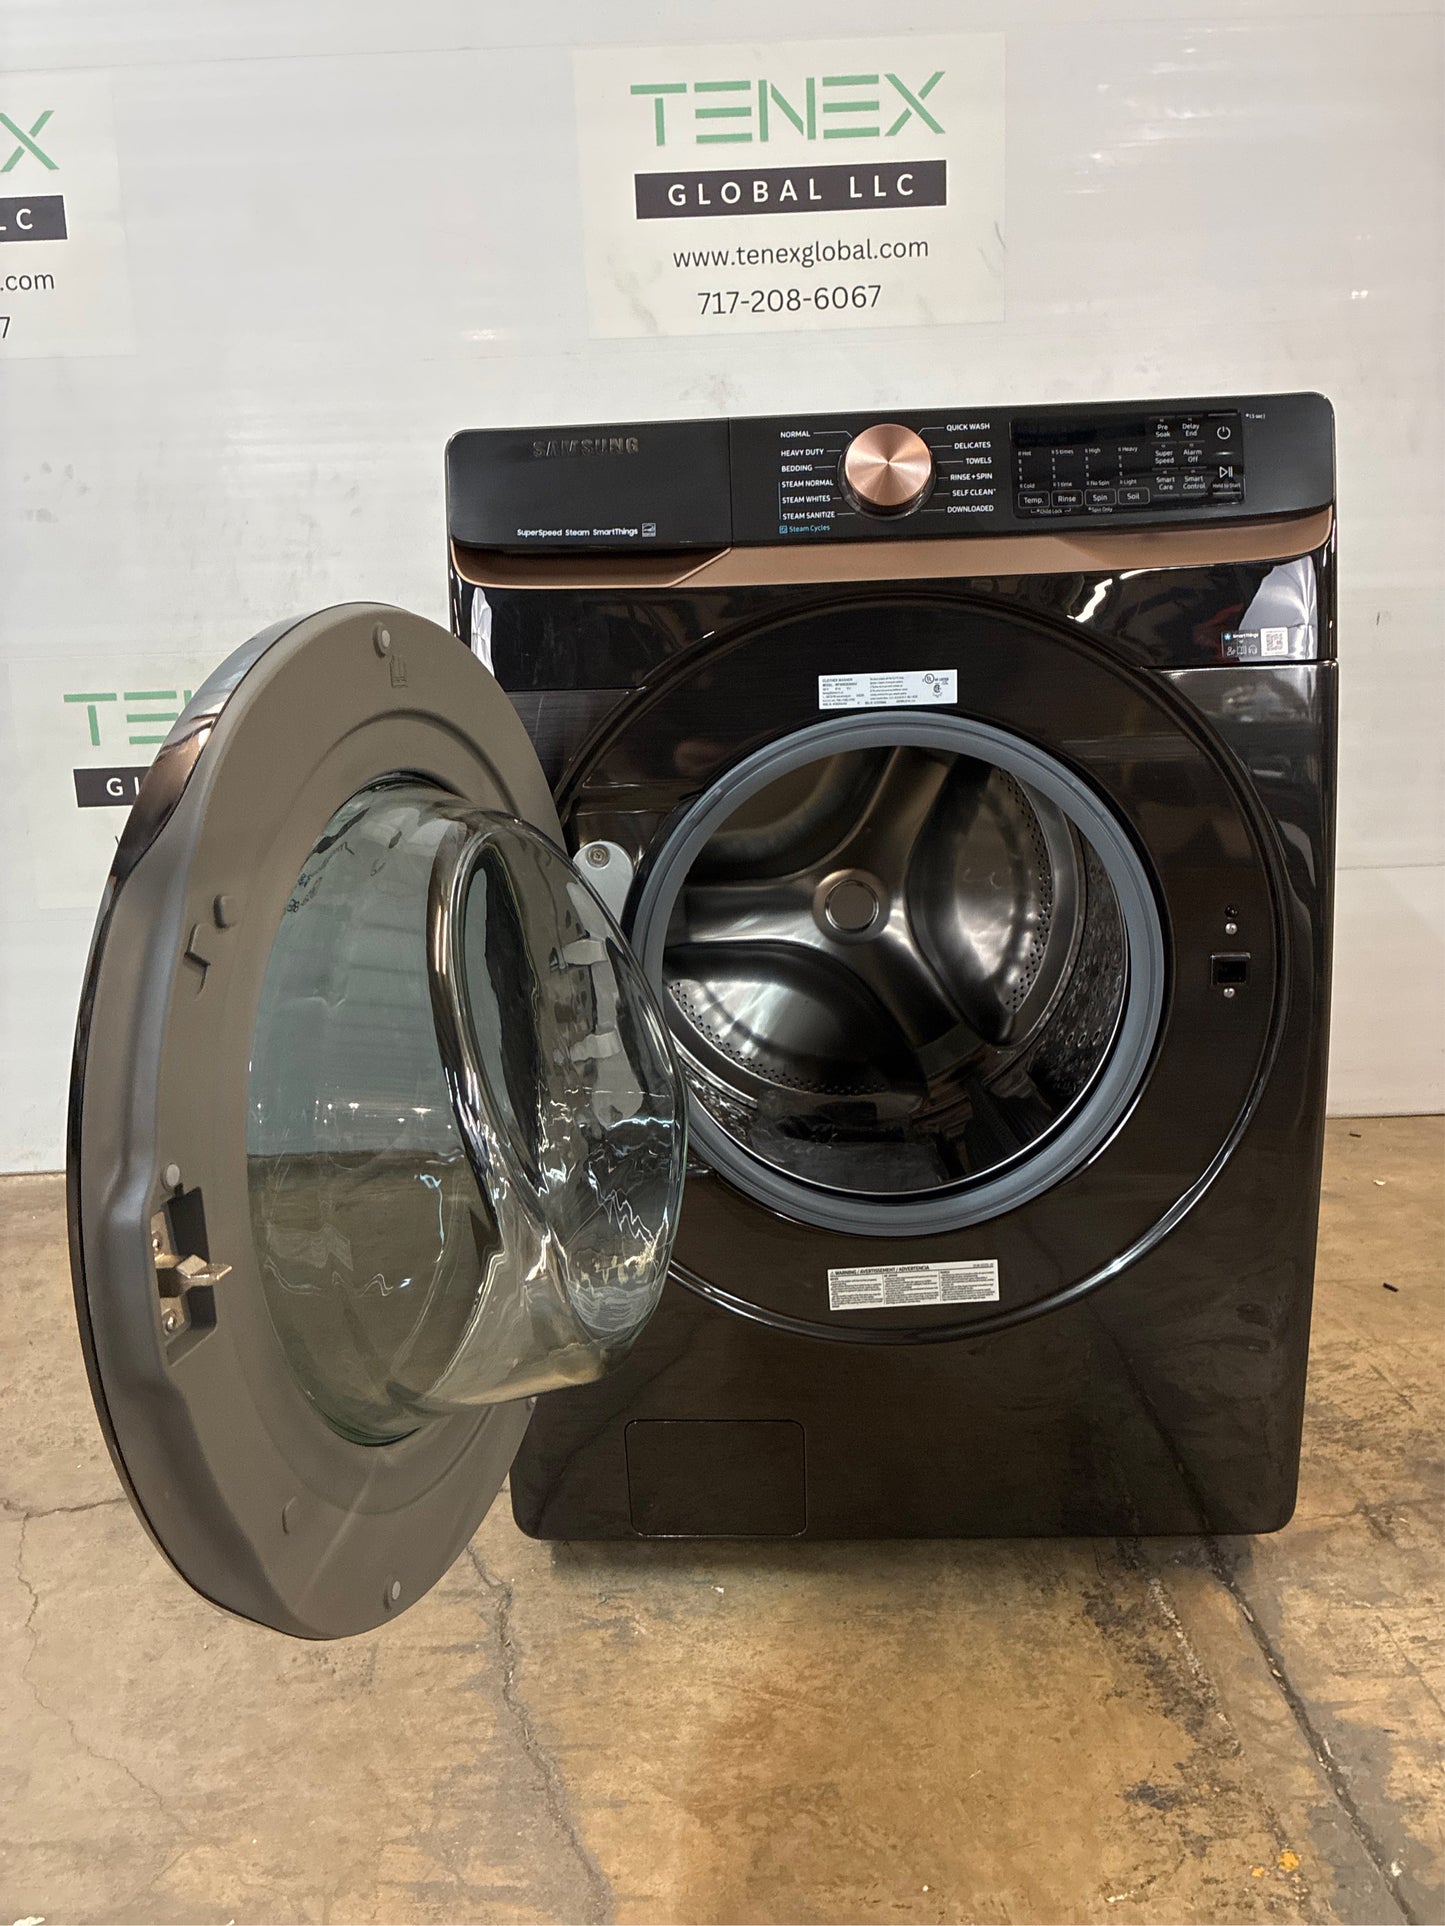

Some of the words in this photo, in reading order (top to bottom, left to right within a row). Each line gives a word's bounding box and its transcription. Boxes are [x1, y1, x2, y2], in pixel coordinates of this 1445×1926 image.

[630, 71, 946, 146] TENEX
[667, 178, 822, 207] GLOBAL
[849, 173, 915, 199] LLC
[672, 238, 930, 269] www.tenexglobal.com
[697, 284, 882, 315] 717-208-6067
[946, 423, 968, 432] QUICK
[968, 422, 990, 431] WASH
[1182, 423, 1200, 431] Delay
[780, 430, 811, 439] NORMAL
[532, 436, 639, 458] SAMSUNG
[953, 441, 991, 450] DELICATES
[1121, 445, 1138, 454] Heavy
[780, 448, 804, 457] HEAVY
[805, 447, 824, 456] DUTY
[1088, 447, 1101, 455] High
[1155, 450, 1173, 458] Super
[965, 457, 992, 466] TOWELS
[1155, 457, 1175, 465] Speed
[781, 464, 813, 473] BEDDING
[781, 480, 804, 489] STEAM
[805, 478, 834, 487] NORMAL
[1123, 478, 1137, 486] Light
[1156, 476, 1175, 484] Smart
[1184, 475, 1204, 483] Smart
[1183, 482, 1206, 490] Control
[952, 488, 969, 497] SELF
[1126, 492, 1140, 501] Soil
[781, 496, 805, 505] STEAM
[805, 494, 831, 503] WHITES
[1024, 496, 1044, 504] Temp.
[1057, 494, 1077, 503] Rinse
[1092, 493, 1108, 502] Spin
[946, 504, 994, 514] DOWNLOADED
[782, 511, 805, 520] STEAM
[806, 510, 836, 519] SANITIZE
[516, 528, 563, 538] SuperSpeed
[565, 527, 590, 537] Steam
[592, 526, 638, 537] SmartThings
[789, 525, 809, 533] Steam
[810, 524, 831, 533] Cycles
[63, 690, 192, 746] TE
